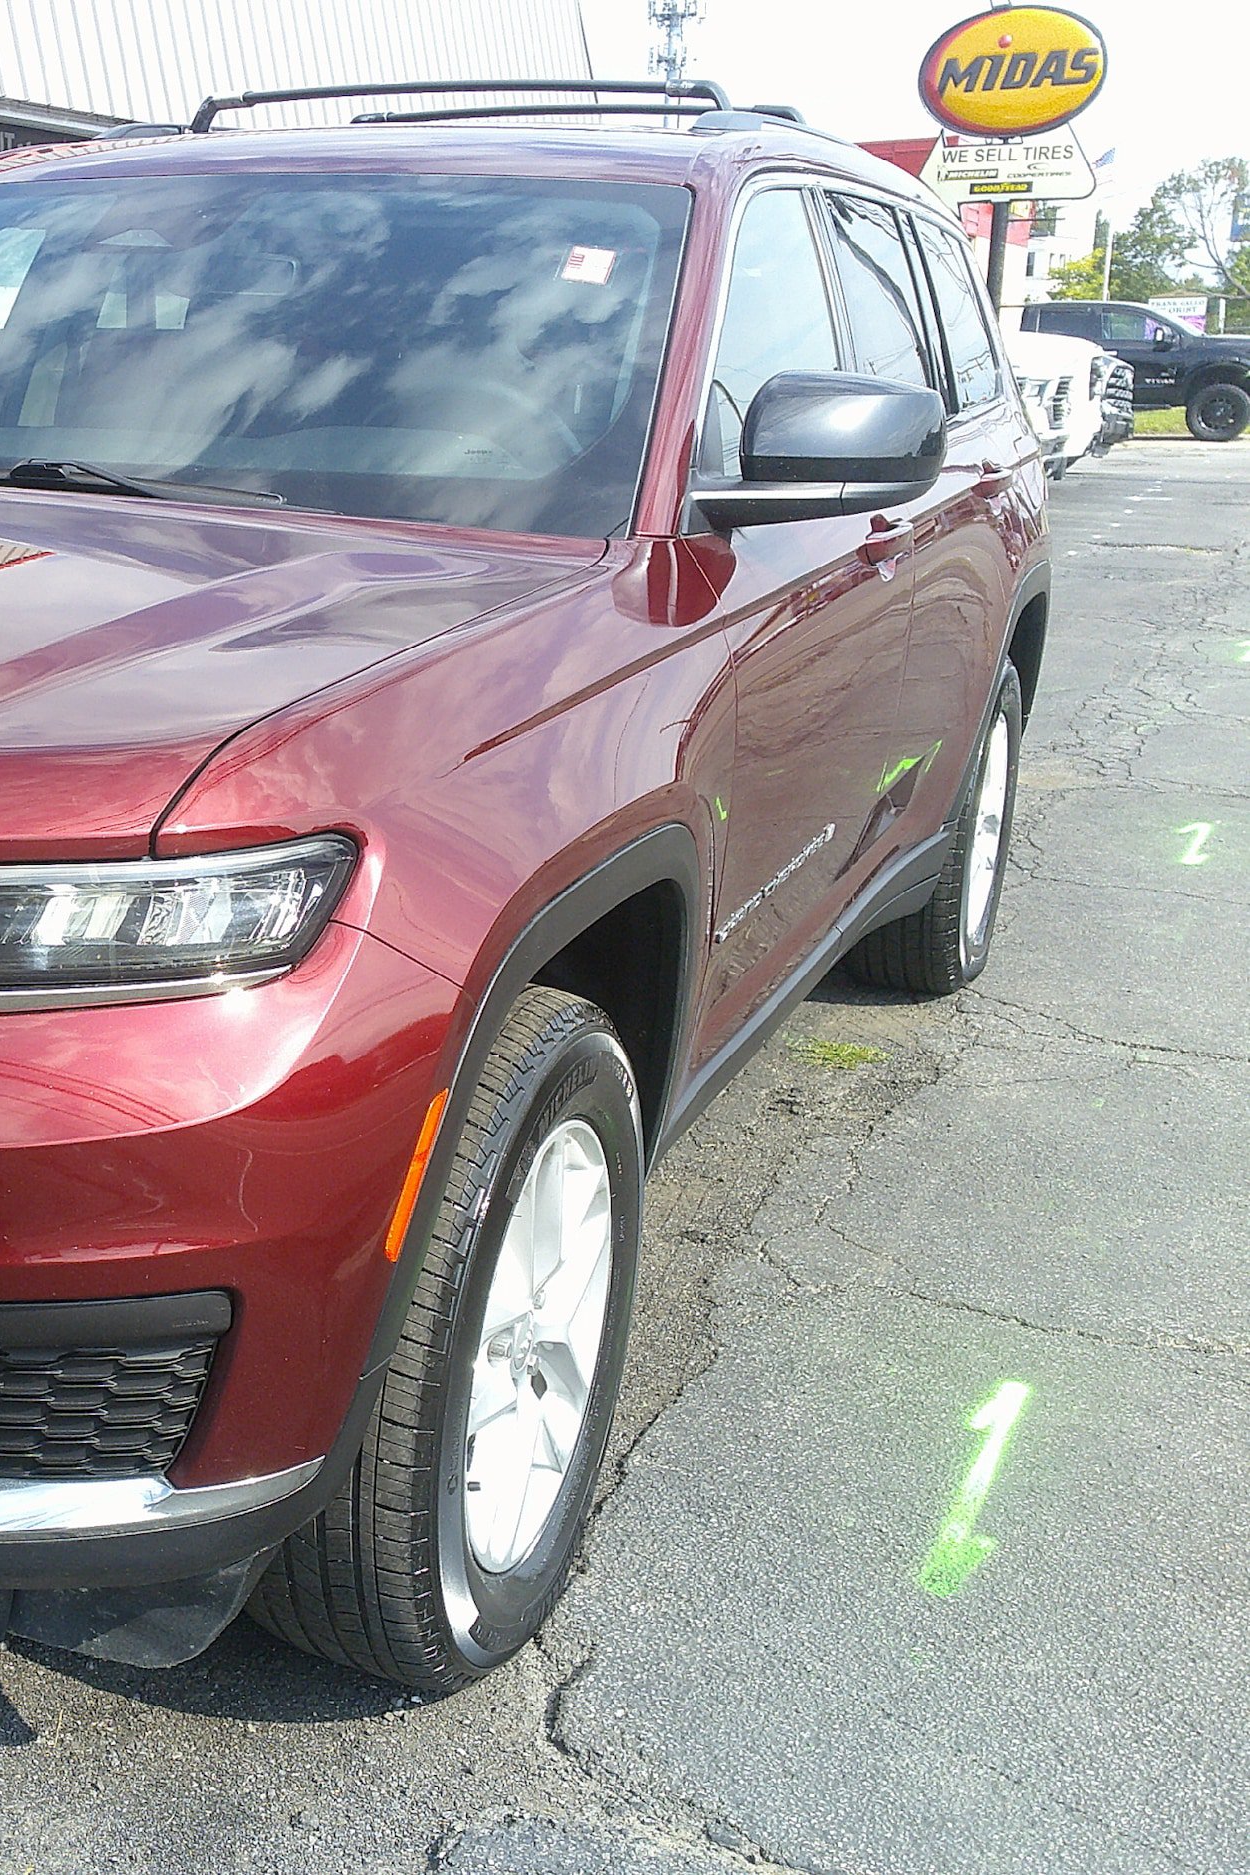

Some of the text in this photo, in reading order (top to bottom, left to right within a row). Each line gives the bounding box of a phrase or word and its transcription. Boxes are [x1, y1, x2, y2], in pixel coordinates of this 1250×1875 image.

[937, 35, 1100, 97] MIDAS
[942, 145, 1074, 163] WE SELL TIRES
